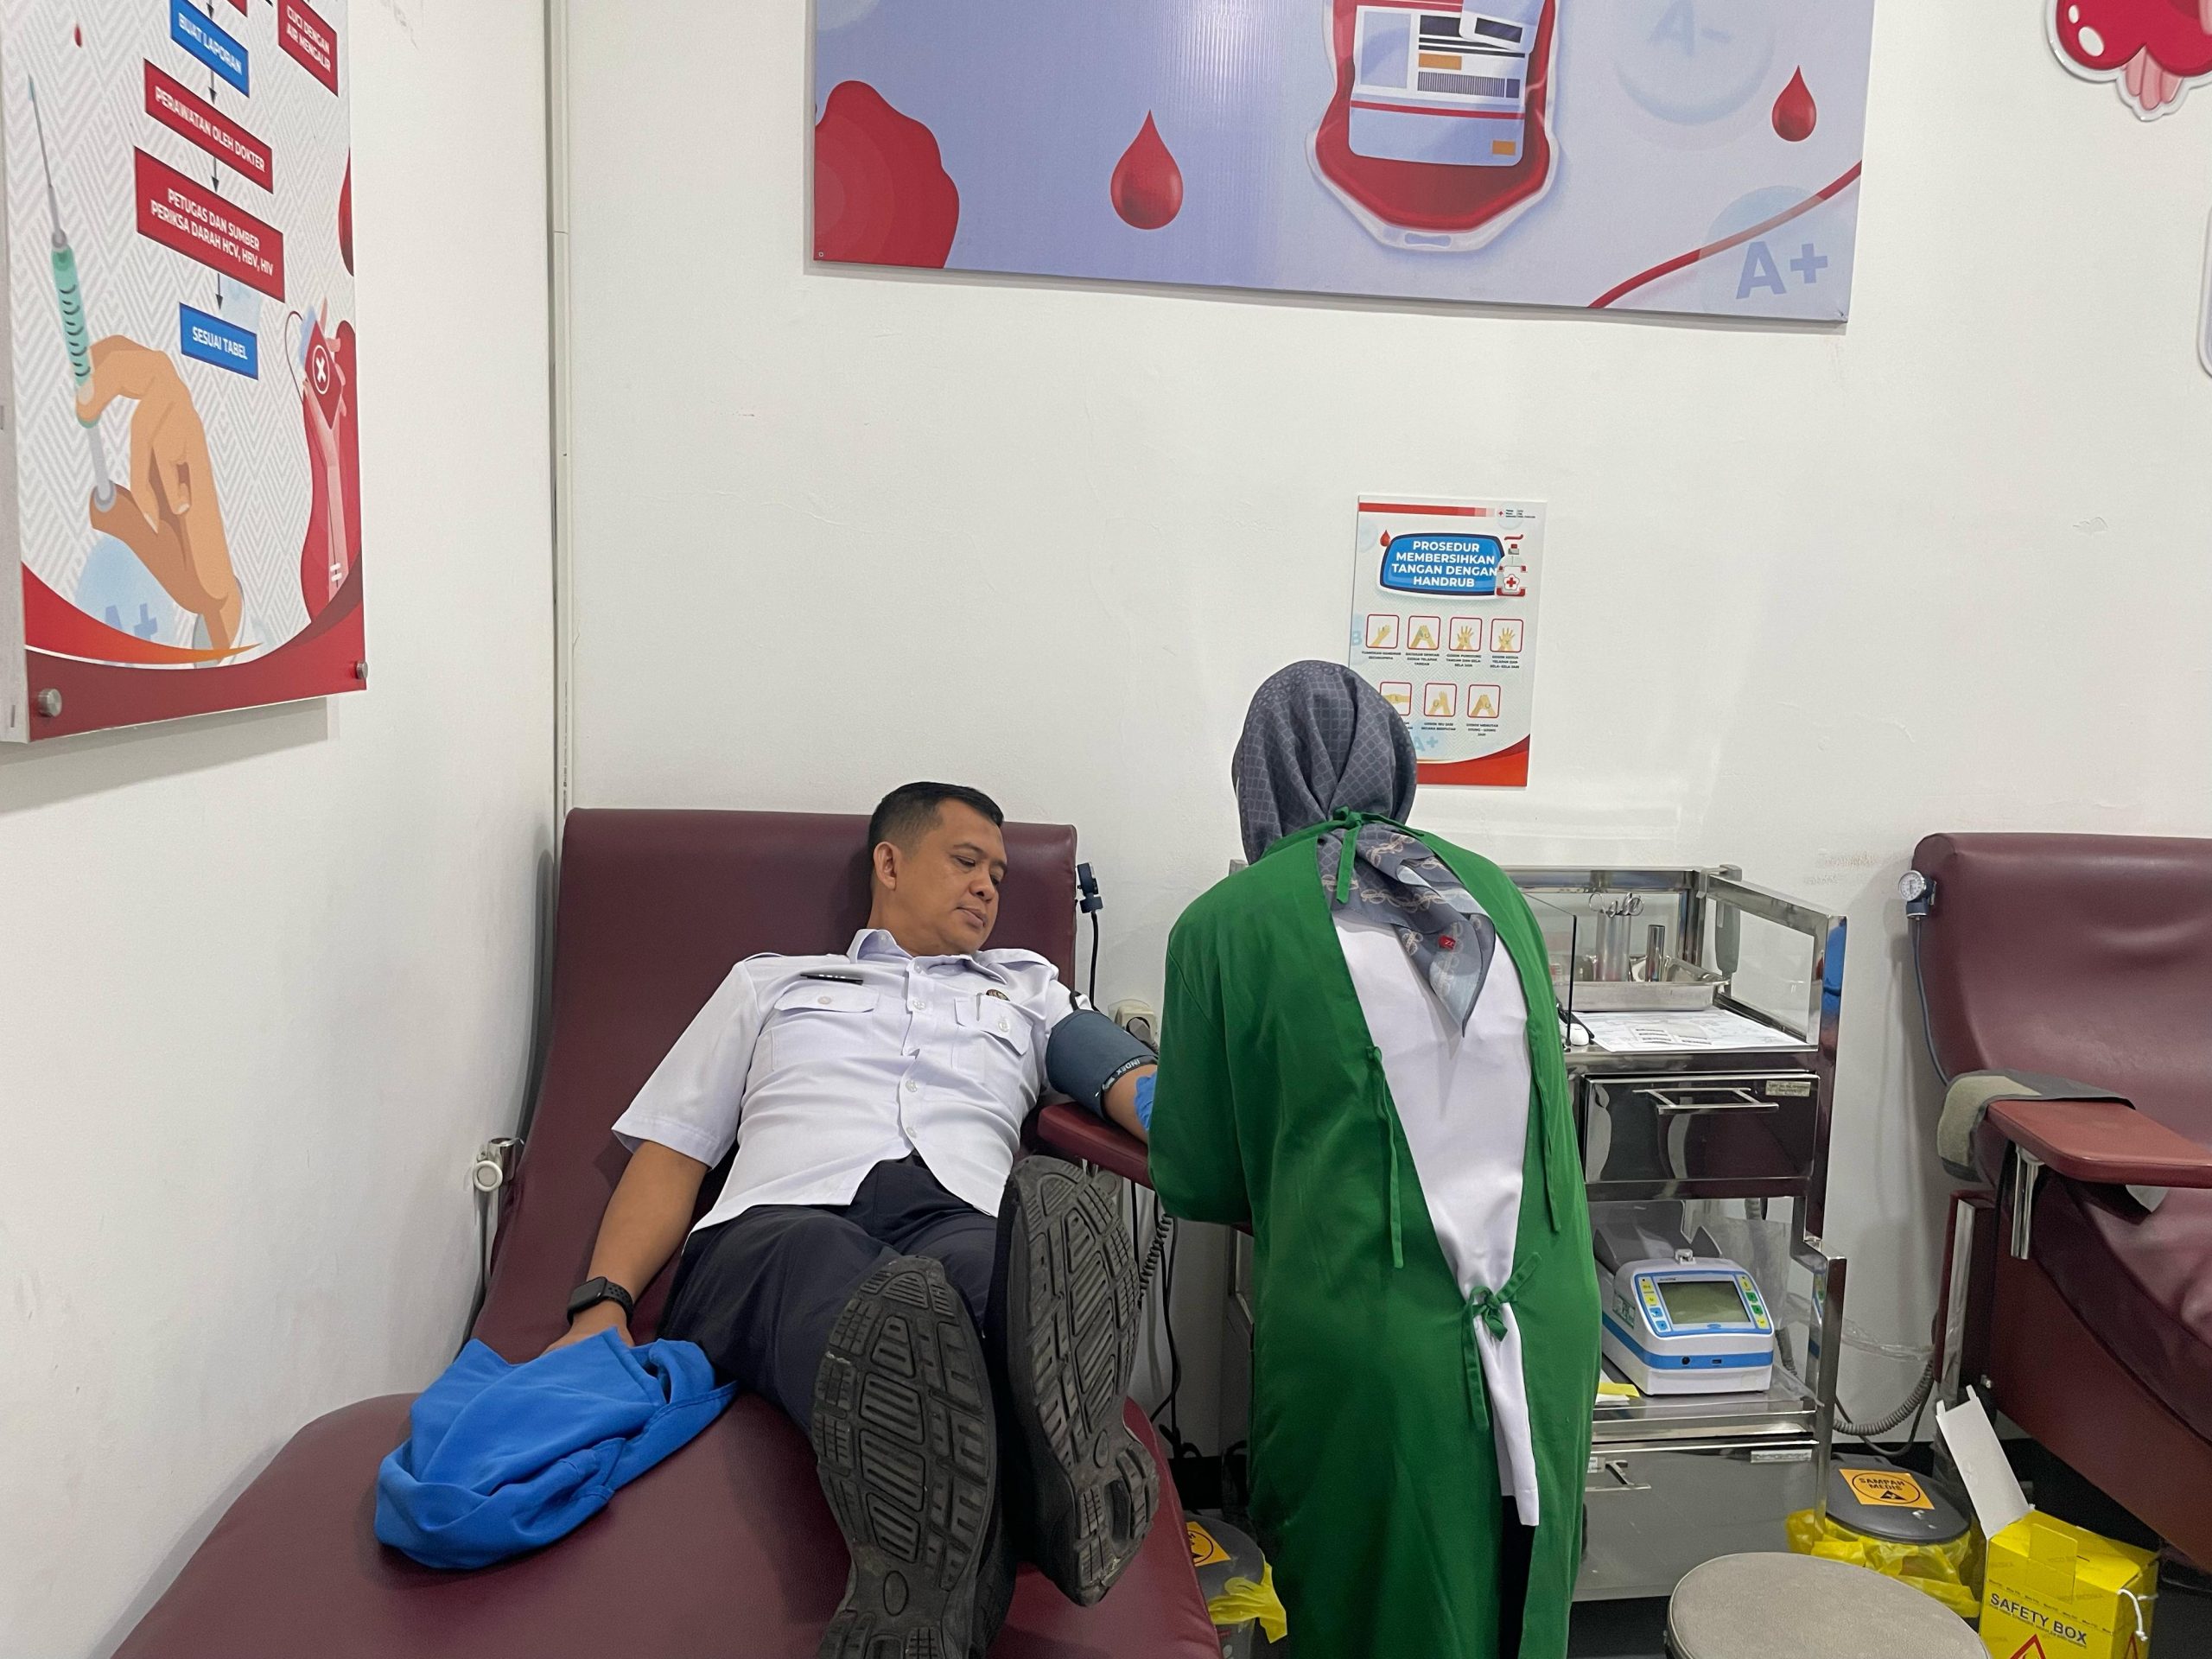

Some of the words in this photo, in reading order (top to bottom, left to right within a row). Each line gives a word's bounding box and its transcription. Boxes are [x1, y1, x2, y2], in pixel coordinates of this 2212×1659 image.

[178, 12, 201, 43] BUAT
[203, 29, 242, 75] LAPORAN
[286, 4, 302, 29] CUCI
[303, 21, 330, 54] DENGAN
[286, 22, 299, 42] AIR
[299, 32, 331, 73] MENGALIR
[155, 85, 212, 137] PERAWATAN
[212, 125, 234, 151] OLEH
[234, 140, 265, 173] DOKTER
[150, 200, 190, 234] PERIKSA
[191, 220, 221, 250] DARAH
[222, 238, 241, 262] HCV,
[242, 250, 260, 272] HBV,
[260, 257, 274, 276] HIV
[168, 188, 208, 222] PETUGAS
[209, 211, 227, 234] DAN
[228, 223, 259, 251] SUMBER
[1736, 241, 1827, 299] A+
[192, 326, 223, 351] SESUAI
[223, 338, 248, 360] TABEL
[1392, 563, 1443, 575] TANGAN
[1446, 566, 1497, 576] DENGAN
[1395, 552, 1495, 565] MEMBERSIHKAN
[1413, 541, 1480, 553] PROSEDUR
[1413, 576, 1475, 588] HANDRUB
[1859, 1478, 1905, 1486] SAMPAH
[1990, 1592, 2050, 1627] SAFETY
[2053, 1620, 2087, 1645] BOX
